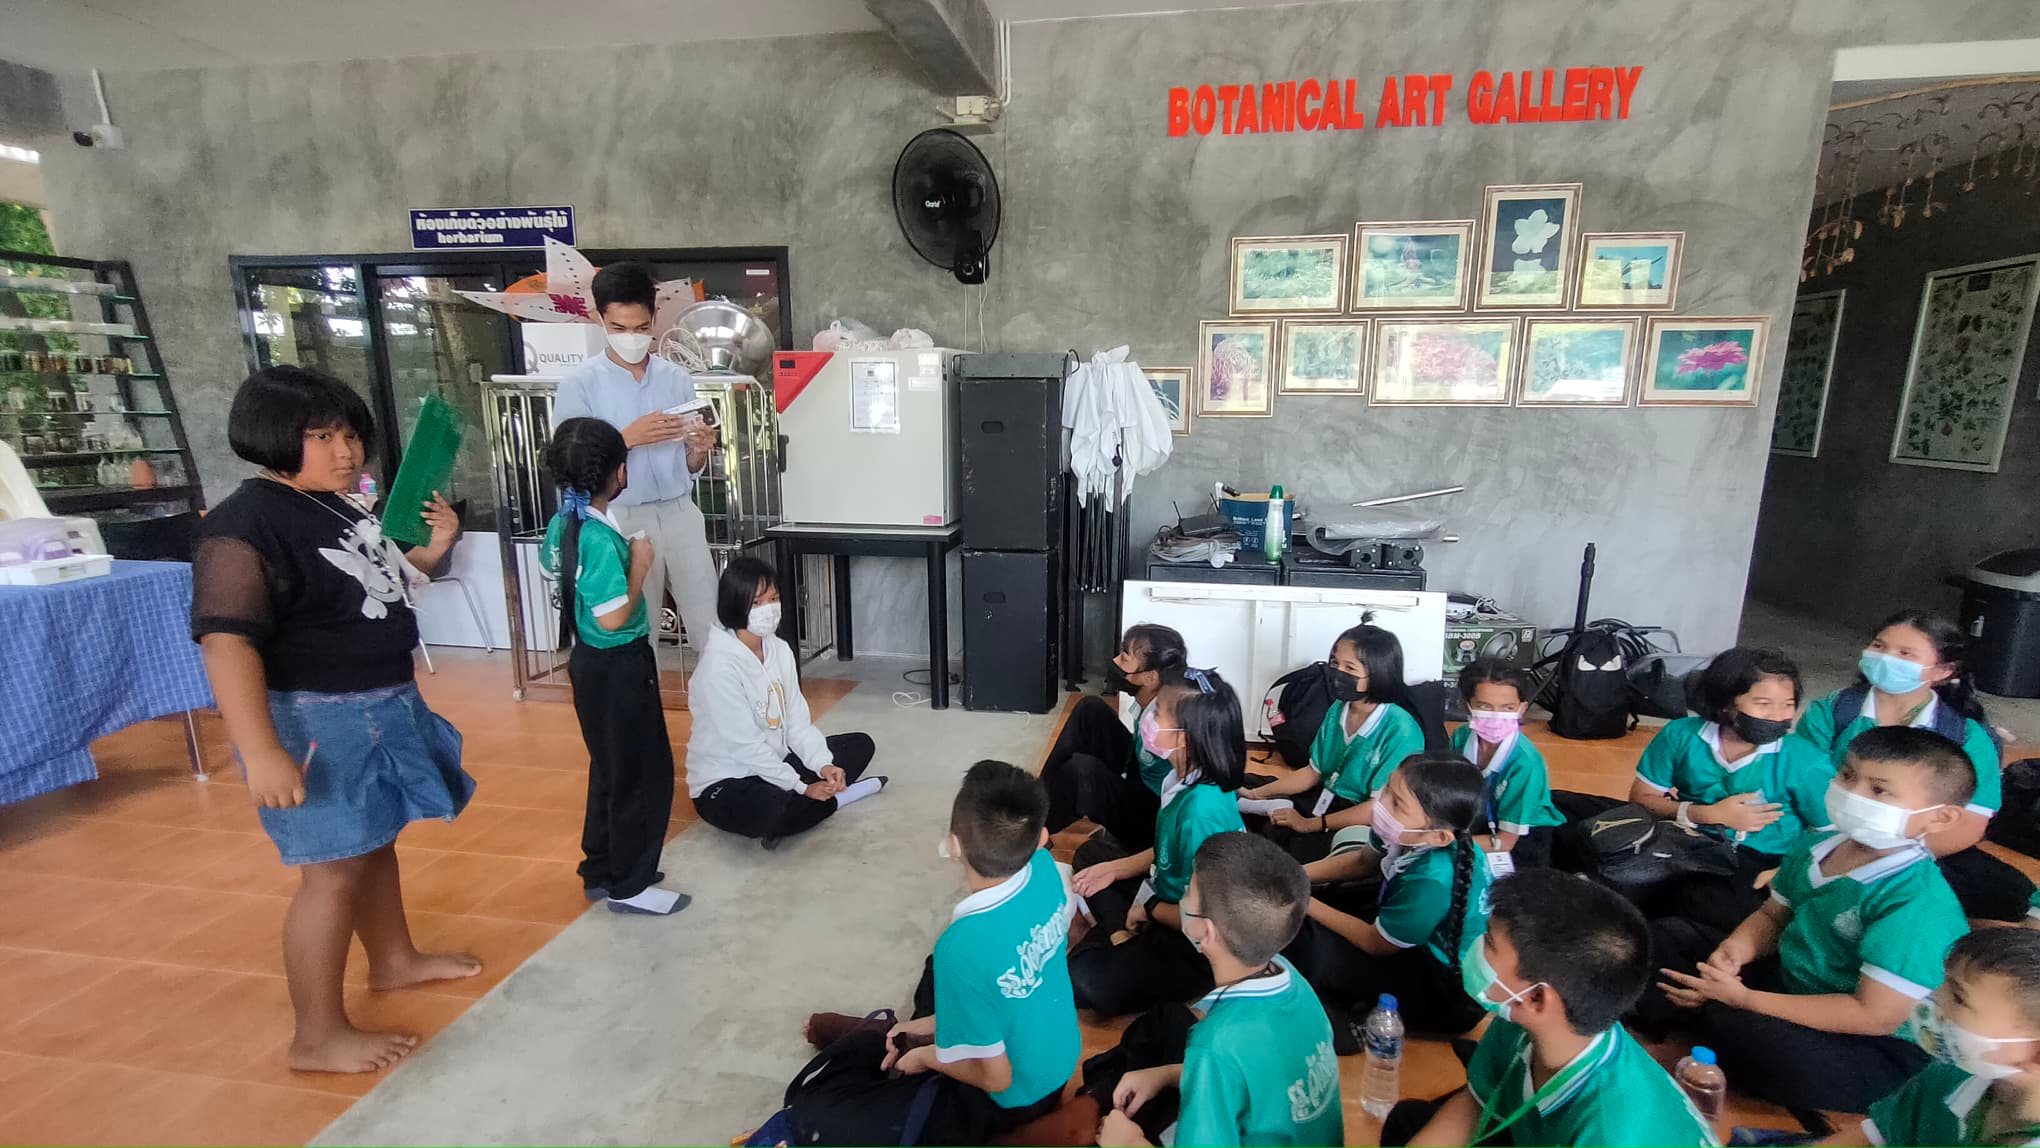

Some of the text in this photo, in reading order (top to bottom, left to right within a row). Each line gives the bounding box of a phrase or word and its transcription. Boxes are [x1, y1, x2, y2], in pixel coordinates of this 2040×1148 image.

[1167, 65, 1645, 137] BOTANICAL ART GALLERY
[437, 230, 505, 244] herbarium
[539, 353, 584, 364] QUALITY
